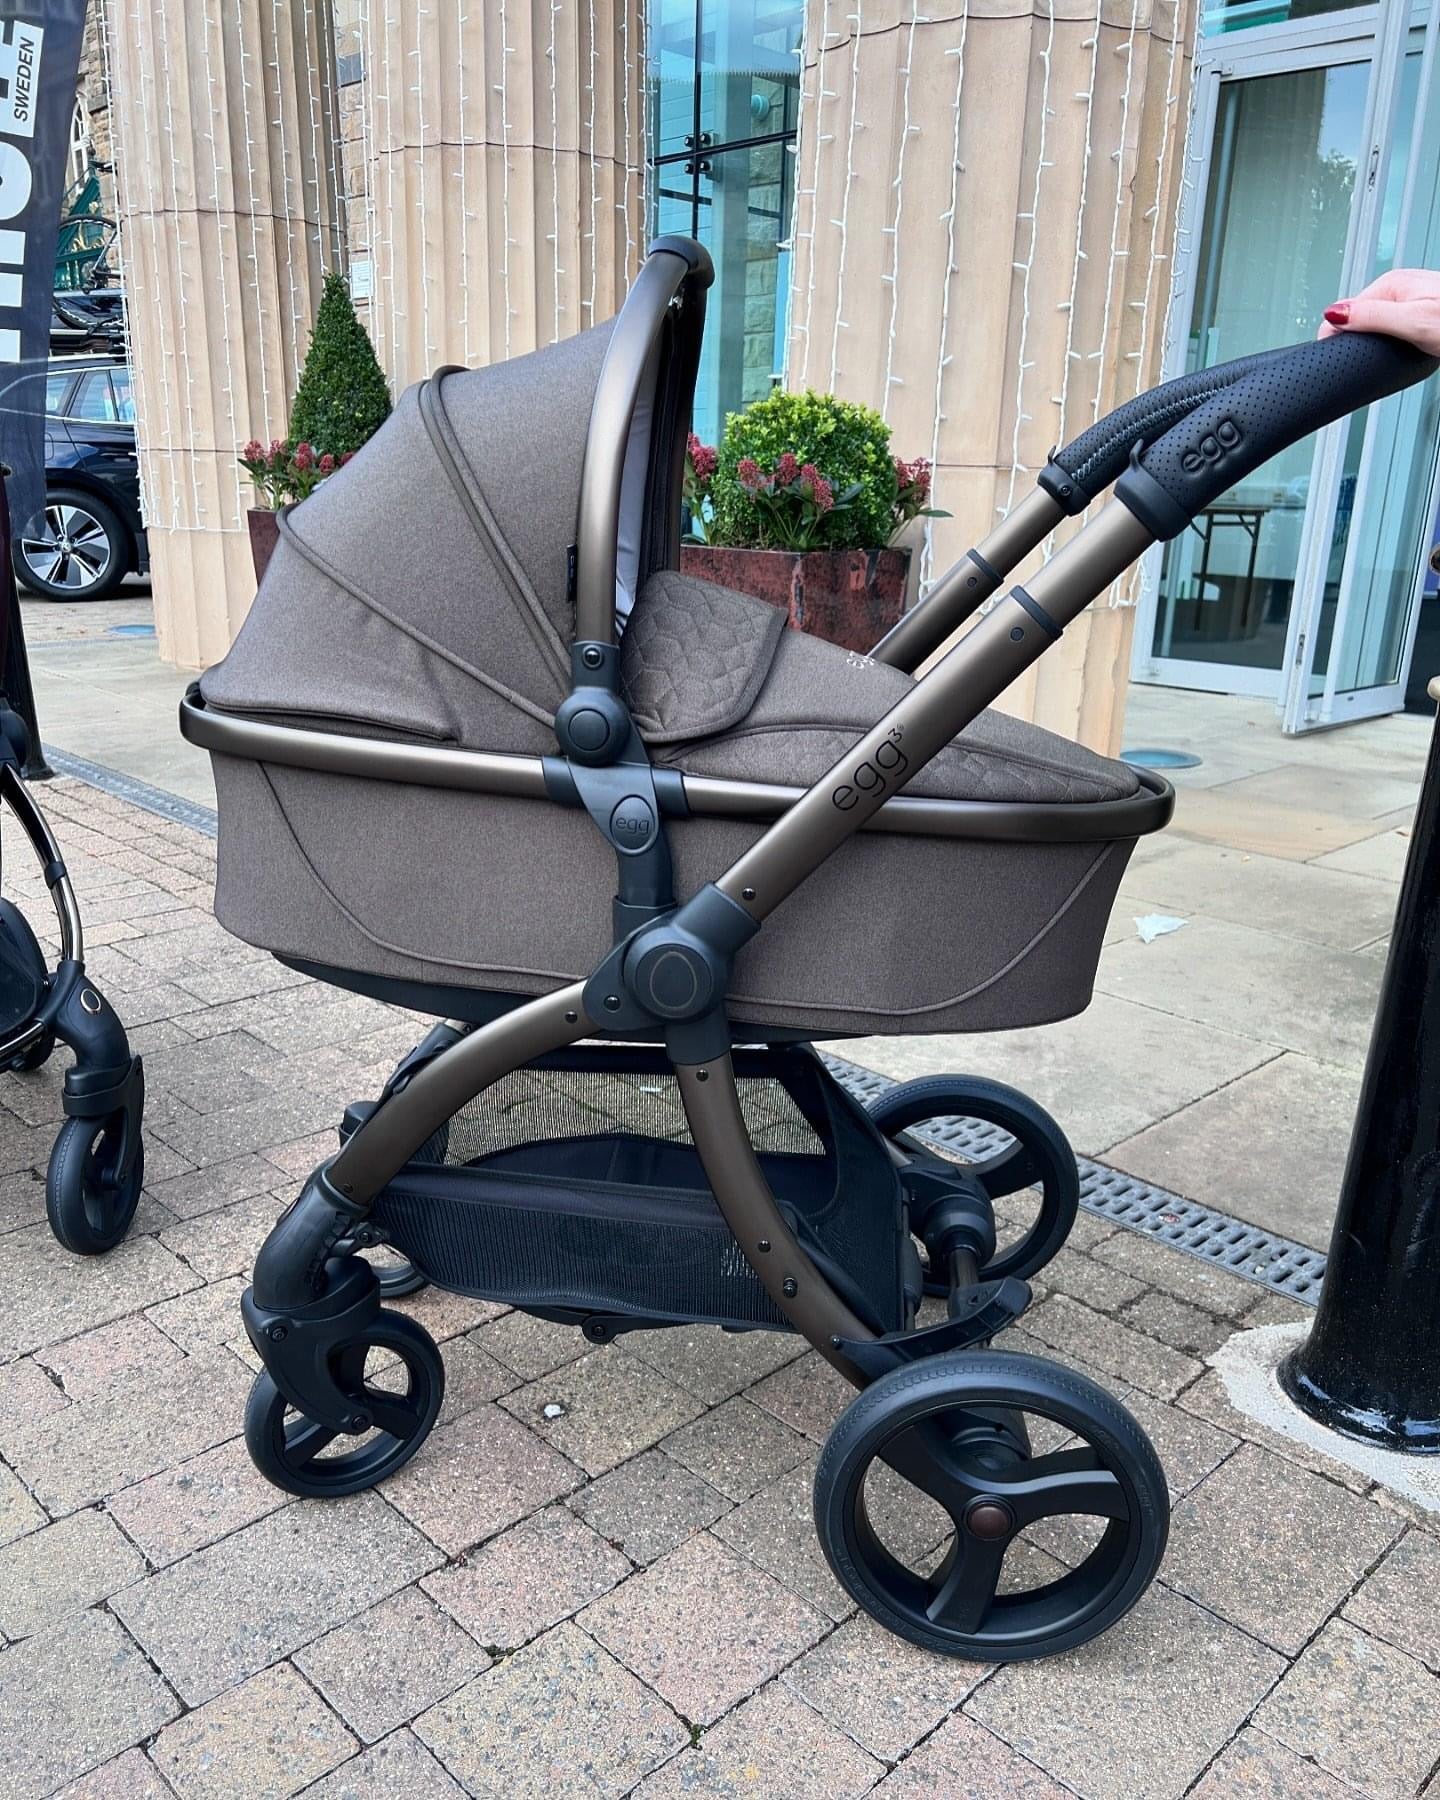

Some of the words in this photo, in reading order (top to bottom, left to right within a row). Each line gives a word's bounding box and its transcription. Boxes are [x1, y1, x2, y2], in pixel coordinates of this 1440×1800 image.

[13, 36, 35, 122] SWEDEN
[1181, 417, 1243, 477] egg
[615, 817, 650, 835] egg
